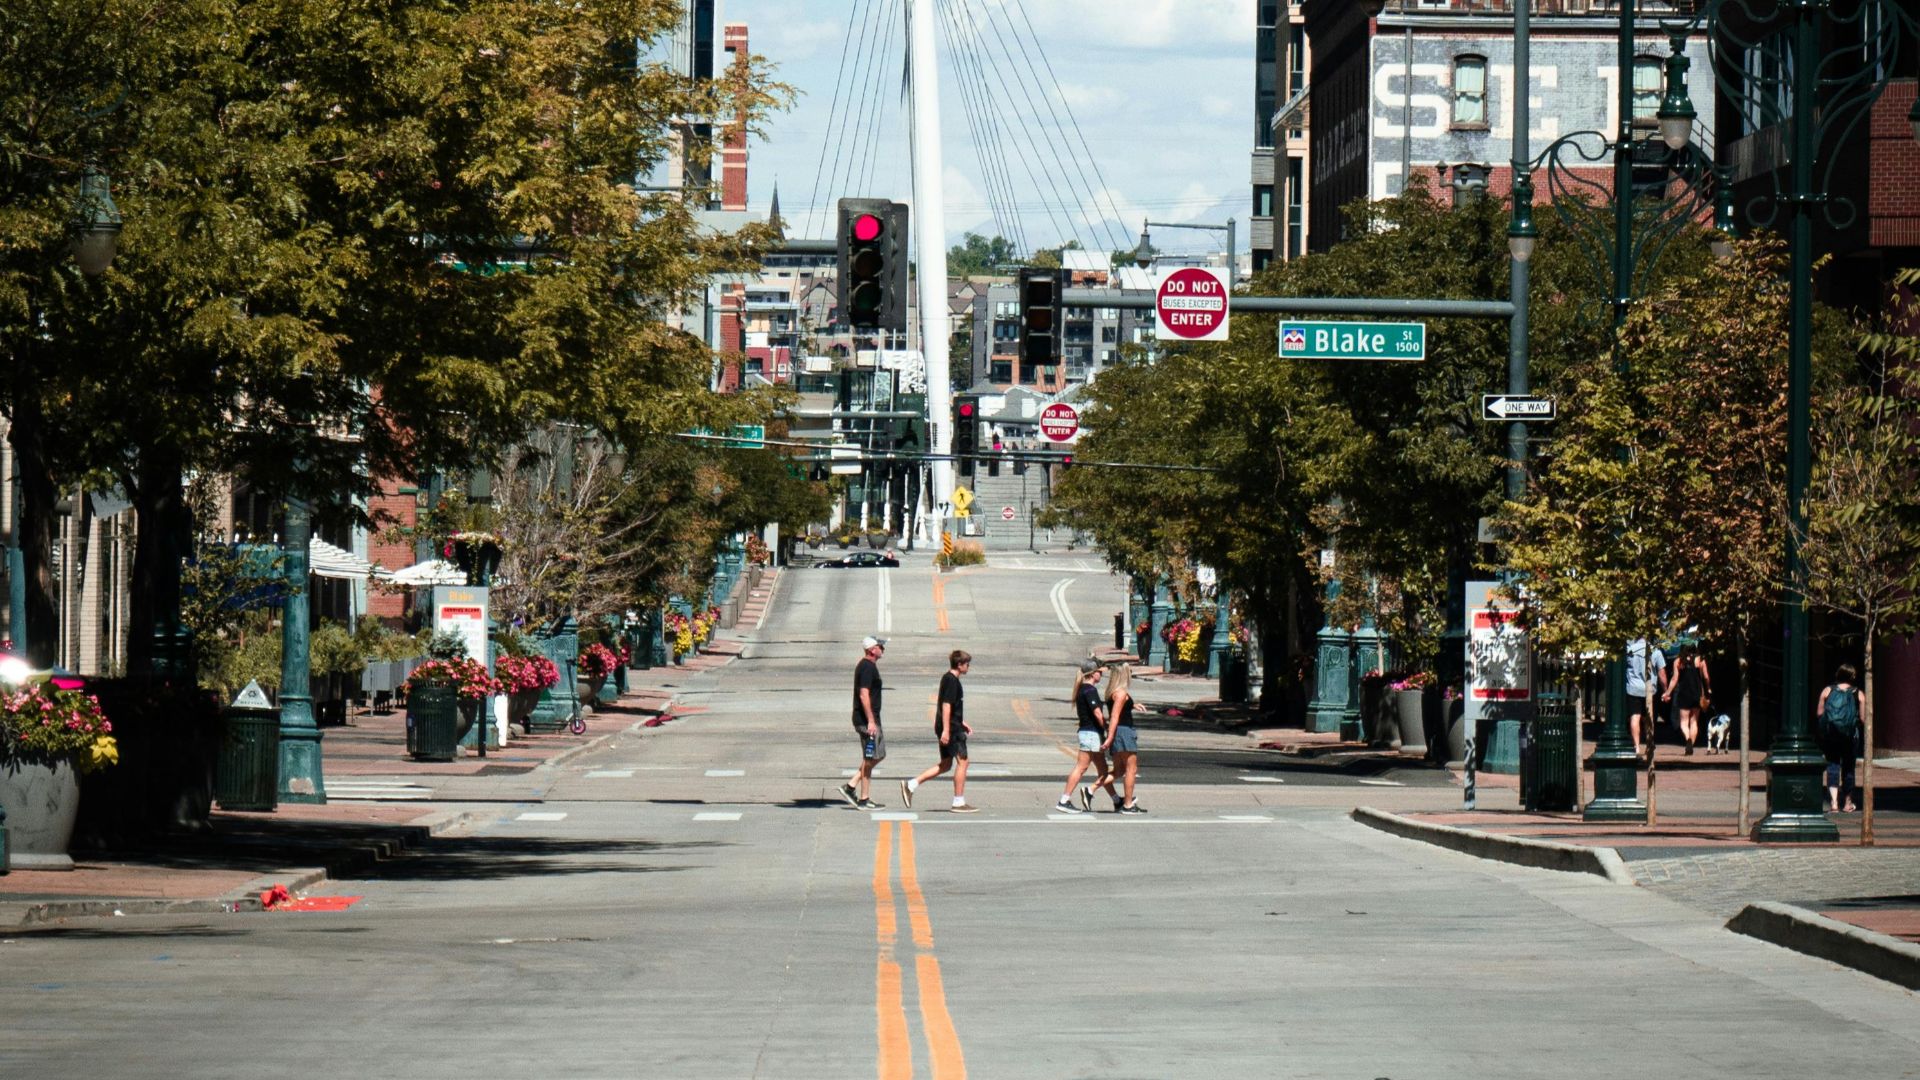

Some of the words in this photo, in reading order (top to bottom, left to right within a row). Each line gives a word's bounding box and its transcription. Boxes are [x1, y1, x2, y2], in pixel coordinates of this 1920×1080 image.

[1167, 280, 1185, 293] DO
[1192, 281, 1218, 294] NOT
[1163, 298, 1186, 308] BUSES
[1188, 299, 1222, 309] EXCEPTED
[1171, 313, 1212, 326] ENTER
[1315, 328, 1385, 353] Blake
[1402, 330, 1413, 341] St
[1395, 342, 1420, 352] 1500
[1504, 403, 1524, 412] ONE
[1527, 402, 1547, 412] WAY
[1046, 409, 1056, 417] DO
[1060, 410, 1074, 418] NOT
[1047, 427, 1071, 435] ENTER
